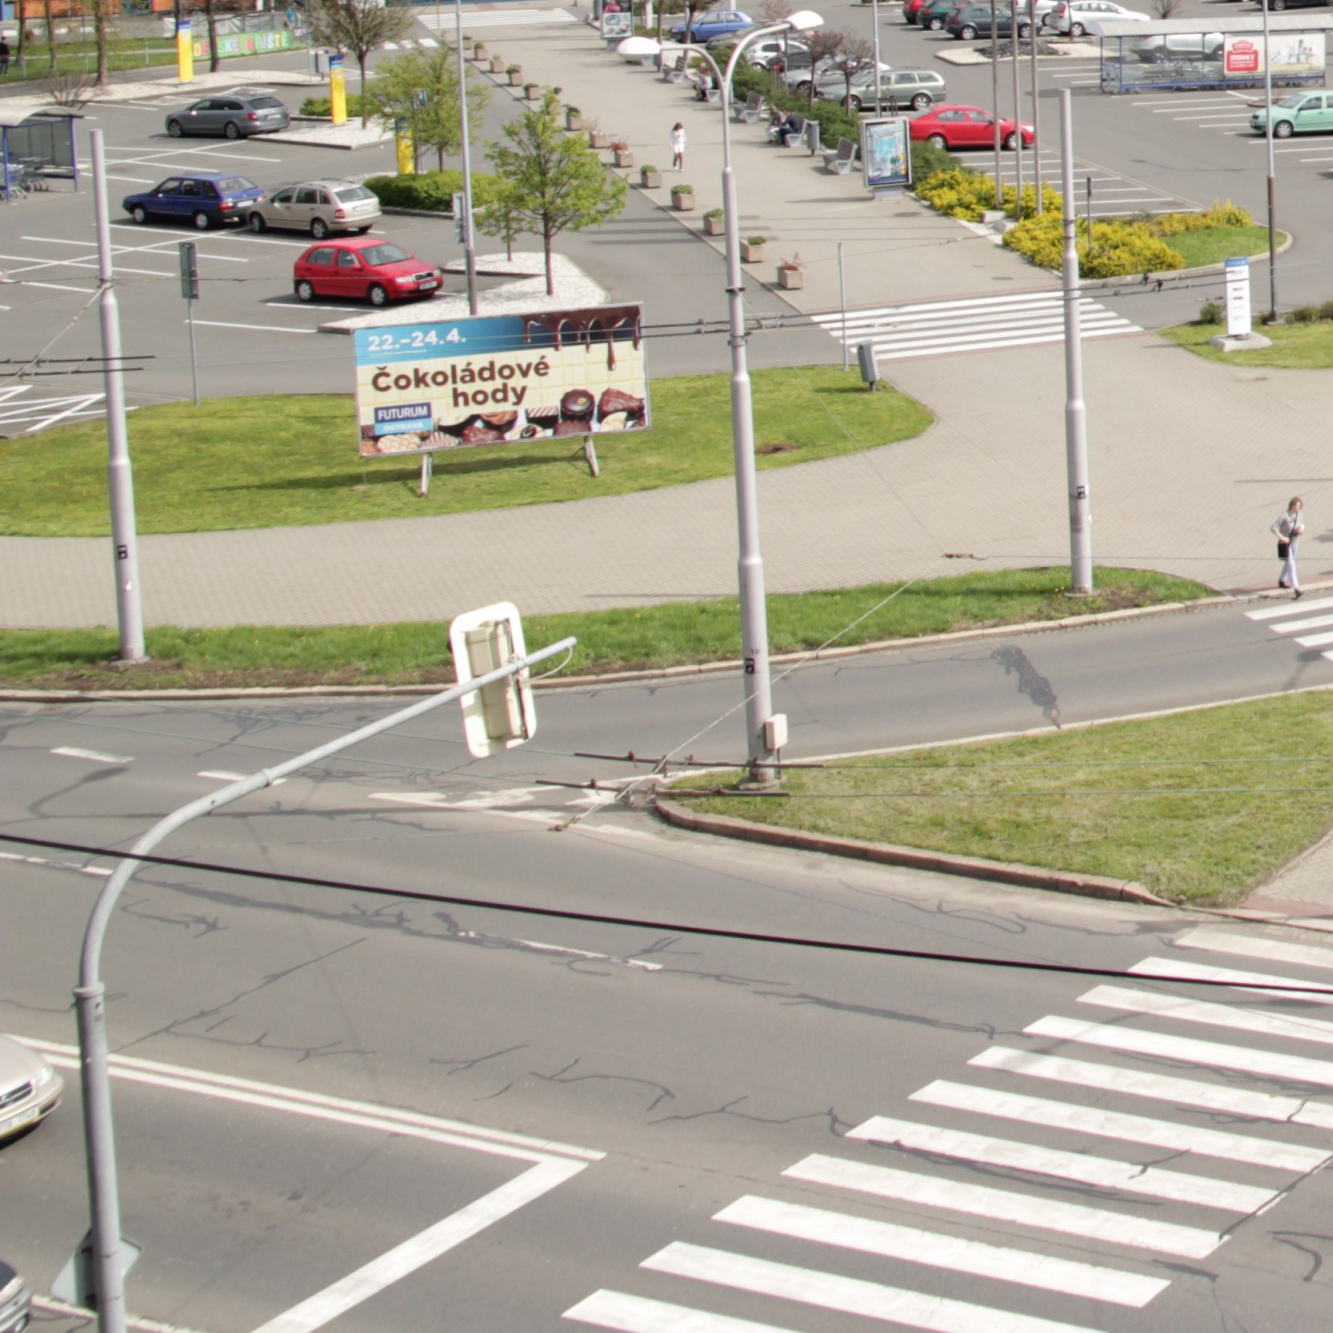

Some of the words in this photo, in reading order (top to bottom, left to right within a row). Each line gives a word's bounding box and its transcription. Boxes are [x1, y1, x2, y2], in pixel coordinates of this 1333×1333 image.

[371, 355, 549, 392] Čokoládové
[452, 382, 527, 407] hody
[377, 406, 429, 421] FUTURUM
